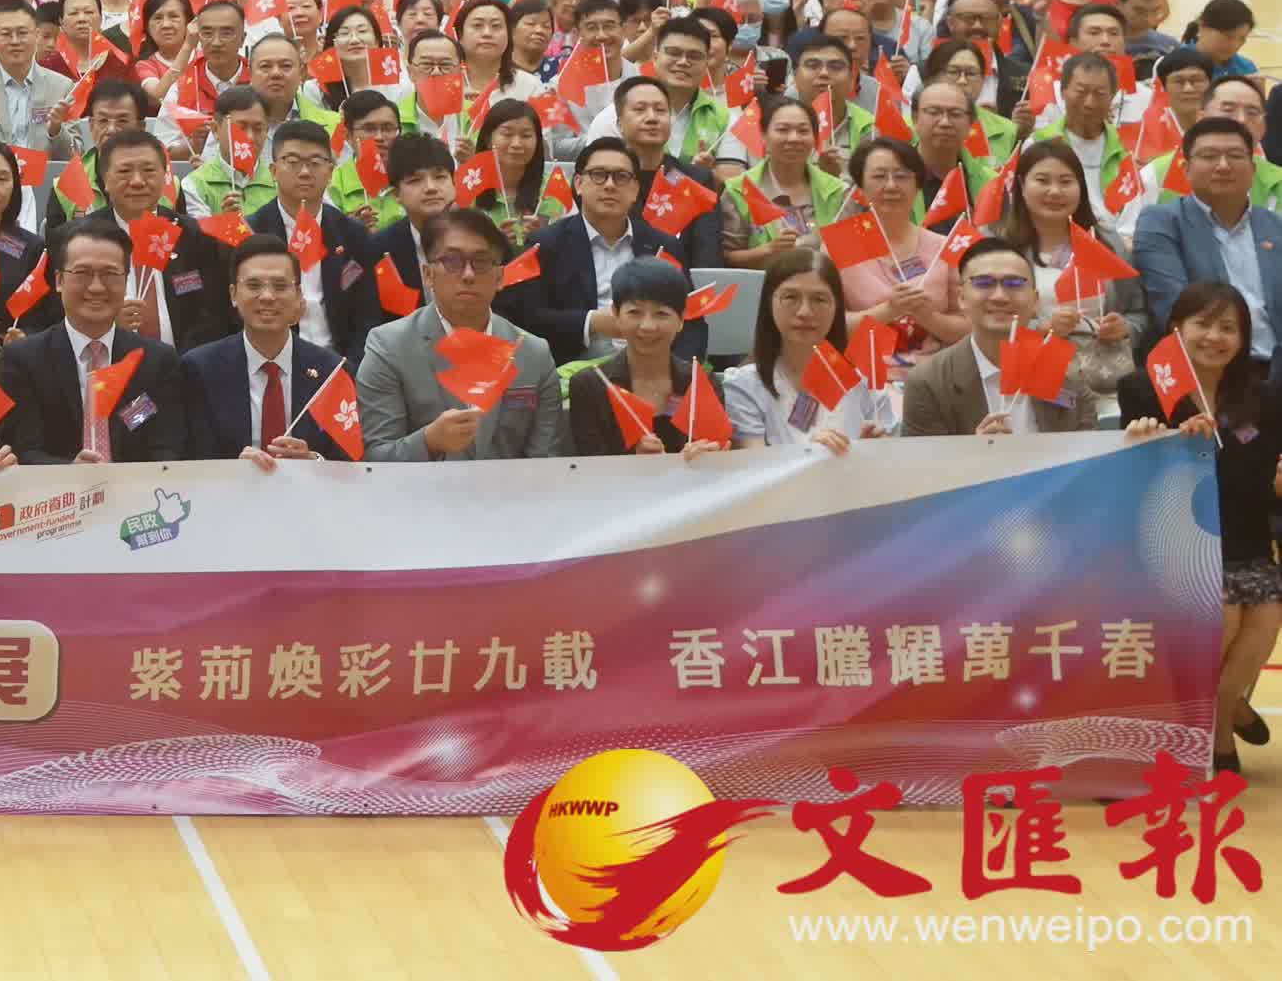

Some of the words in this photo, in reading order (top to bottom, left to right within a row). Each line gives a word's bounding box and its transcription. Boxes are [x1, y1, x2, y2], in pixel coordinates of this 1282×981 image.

[20, 492, 76, 521] 政府資助
[36, 520, 82, 540] programme
[126, 513, 158, 533] 民政
[130, 628, 598, 701] 紫荊煥彩廿九載
[669, 618, 1157, 689] 香江騰耀萬千春
